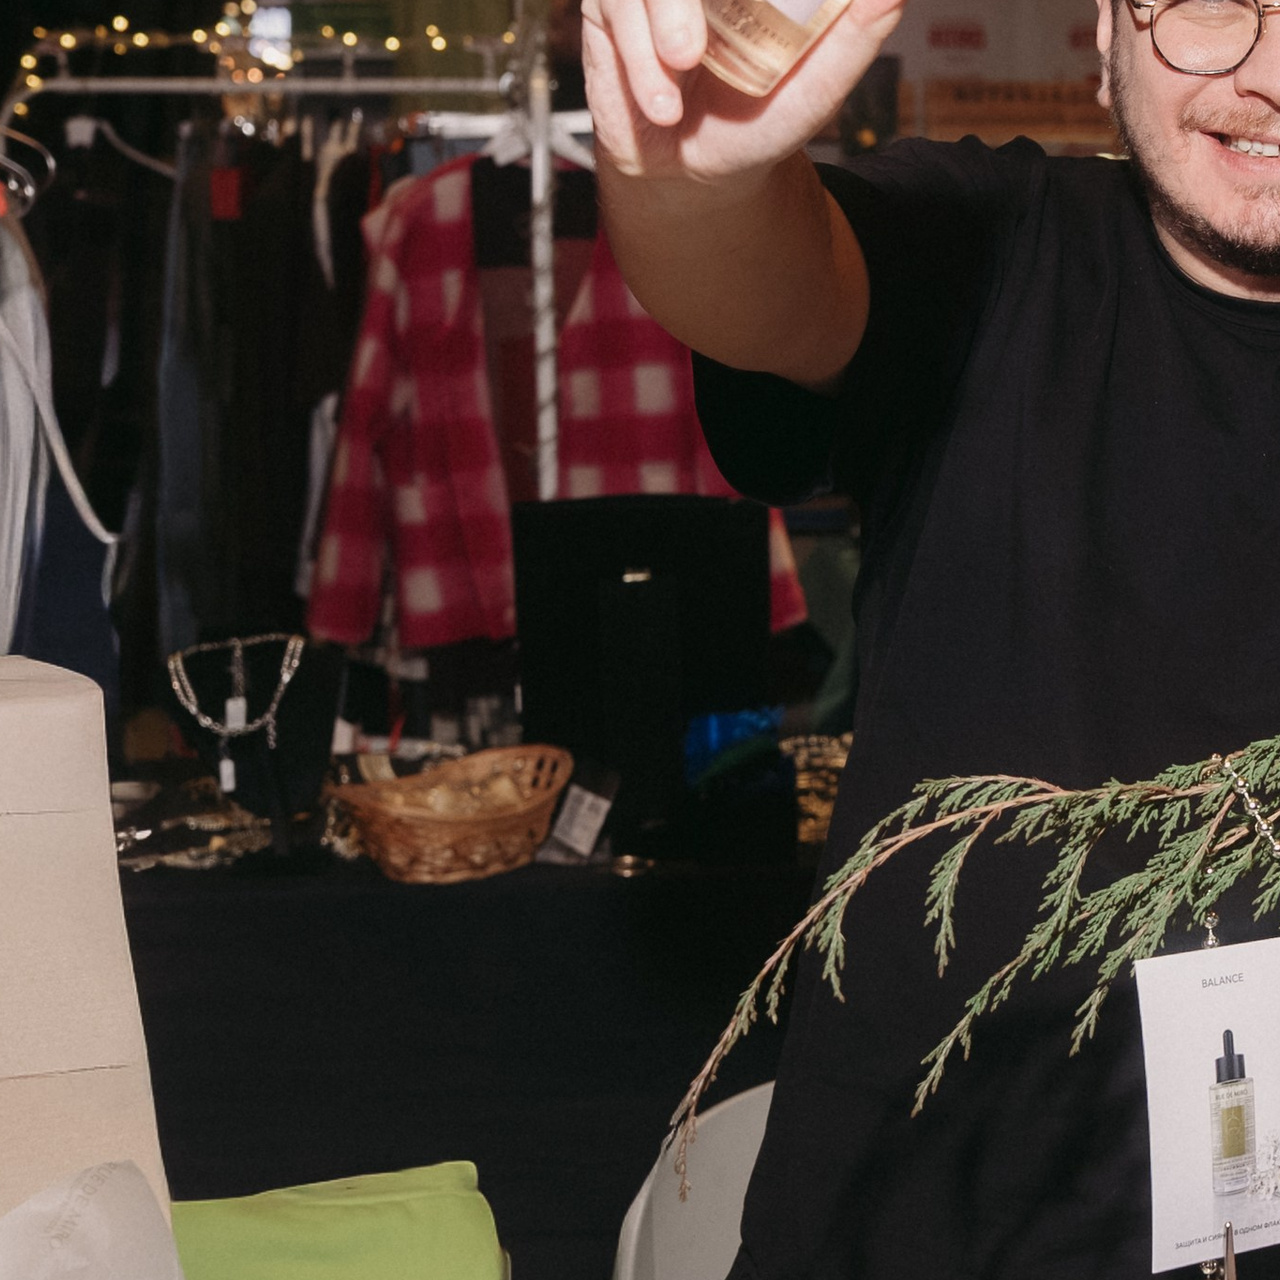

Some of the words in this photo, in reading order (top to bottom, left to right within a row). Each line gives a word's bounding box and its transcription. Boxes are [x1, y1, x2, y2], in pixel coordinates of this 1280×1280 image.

[1201, 972, 1244, 989] BALANCE
[1175, 1234, 1202, 1250] ЗАЩИТА
[1239, 1222, 1263, 1235] ОДНОМ
